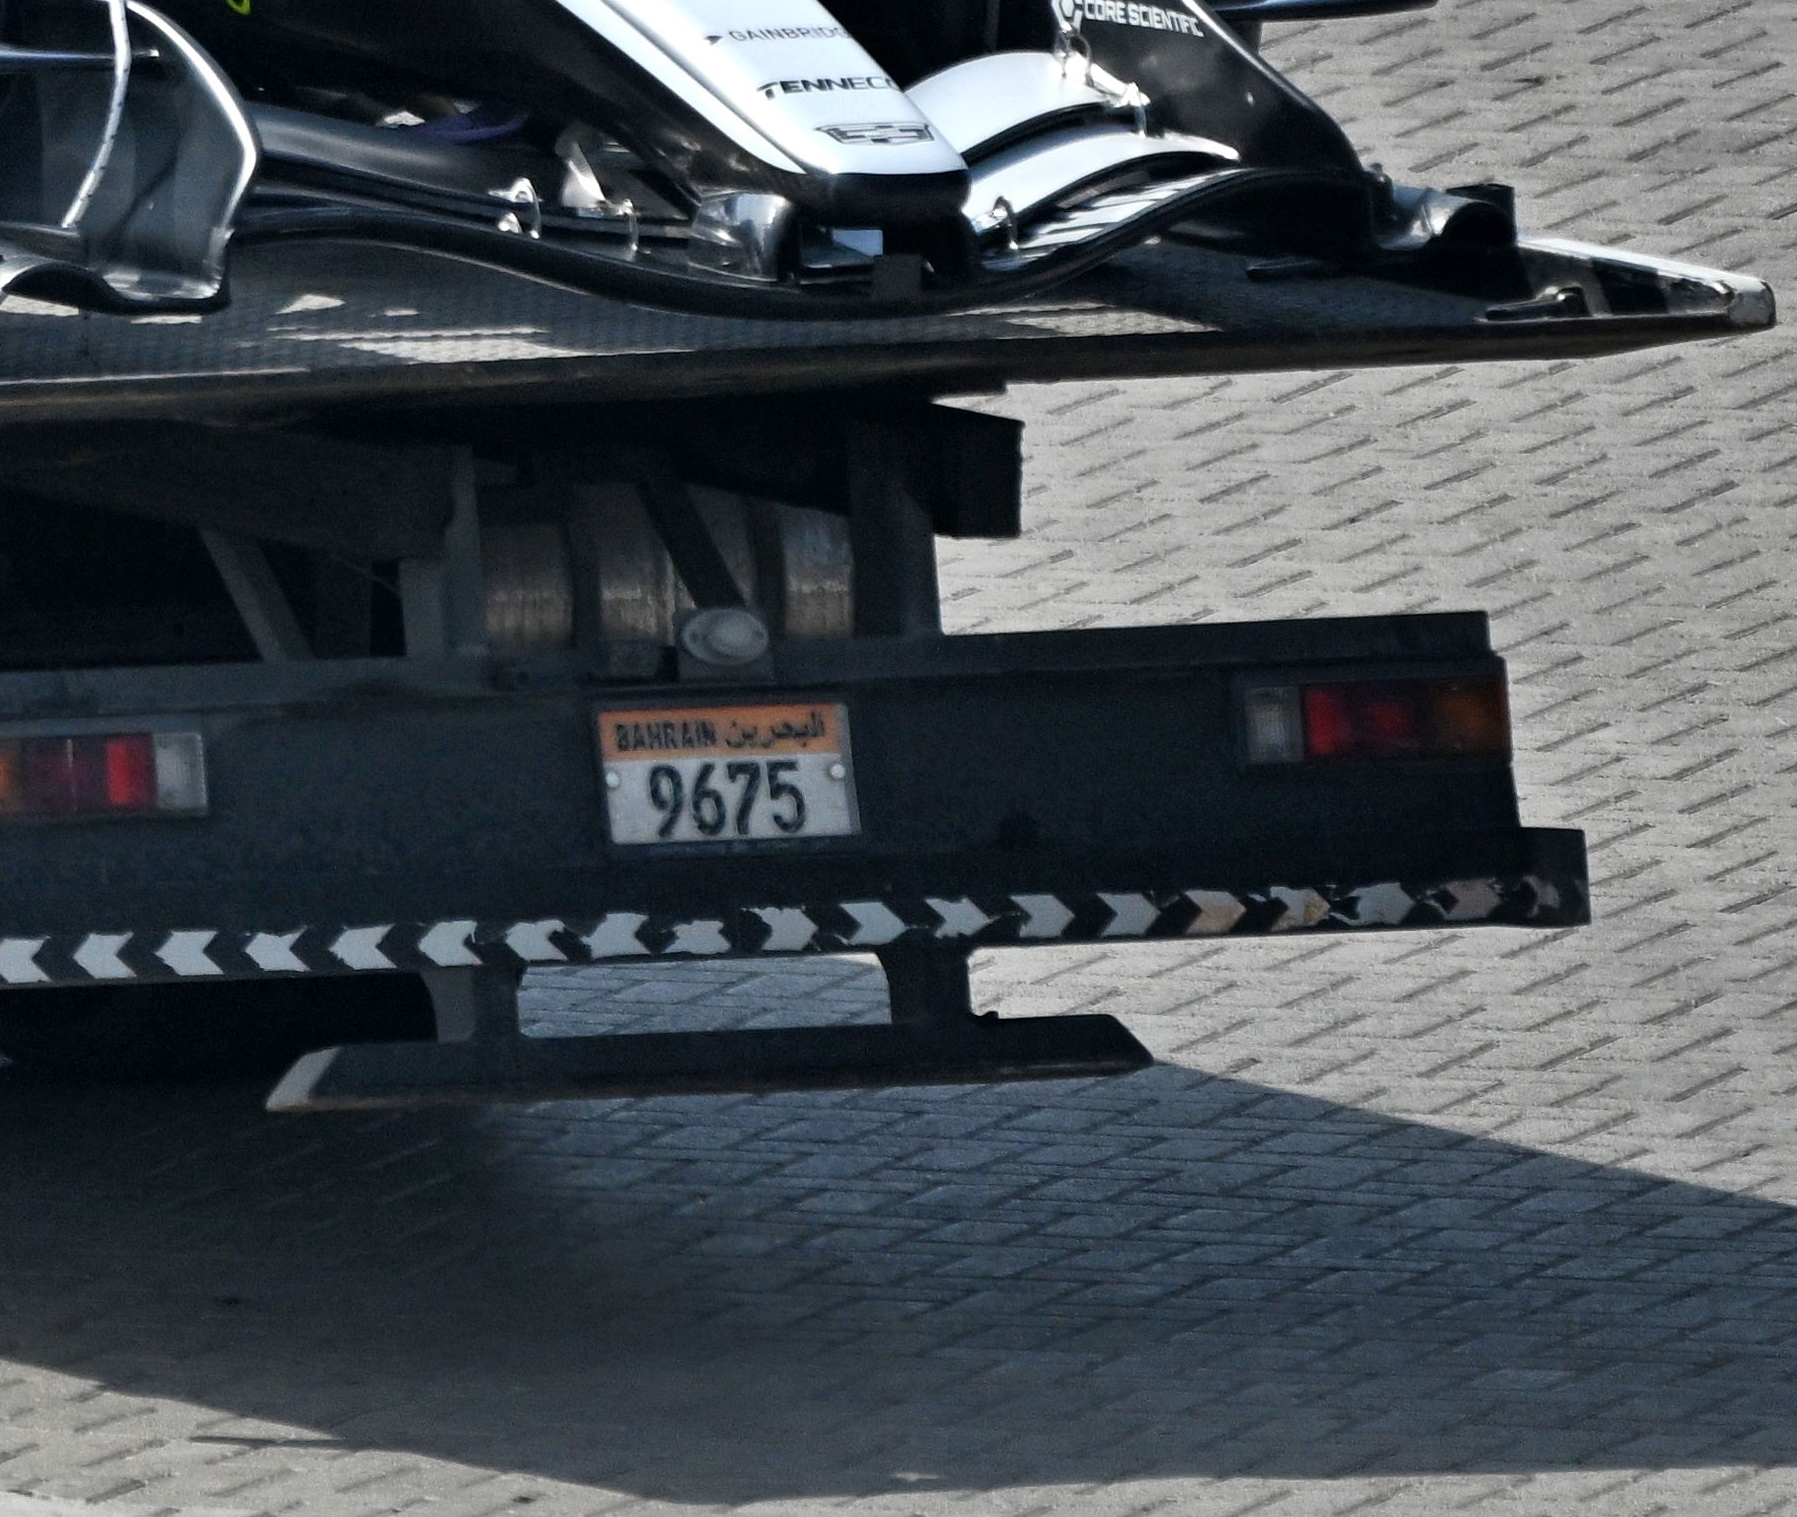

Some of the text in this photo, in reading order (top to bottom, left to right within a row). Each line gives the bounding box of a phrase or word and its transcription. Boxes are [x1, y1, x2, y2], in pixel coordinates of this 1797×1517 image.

[728, 26, 853, 42] GAINBRIDG
[614, 721, 716, 752] BAHRAIN
[649, 758, 806, 839] 9675
